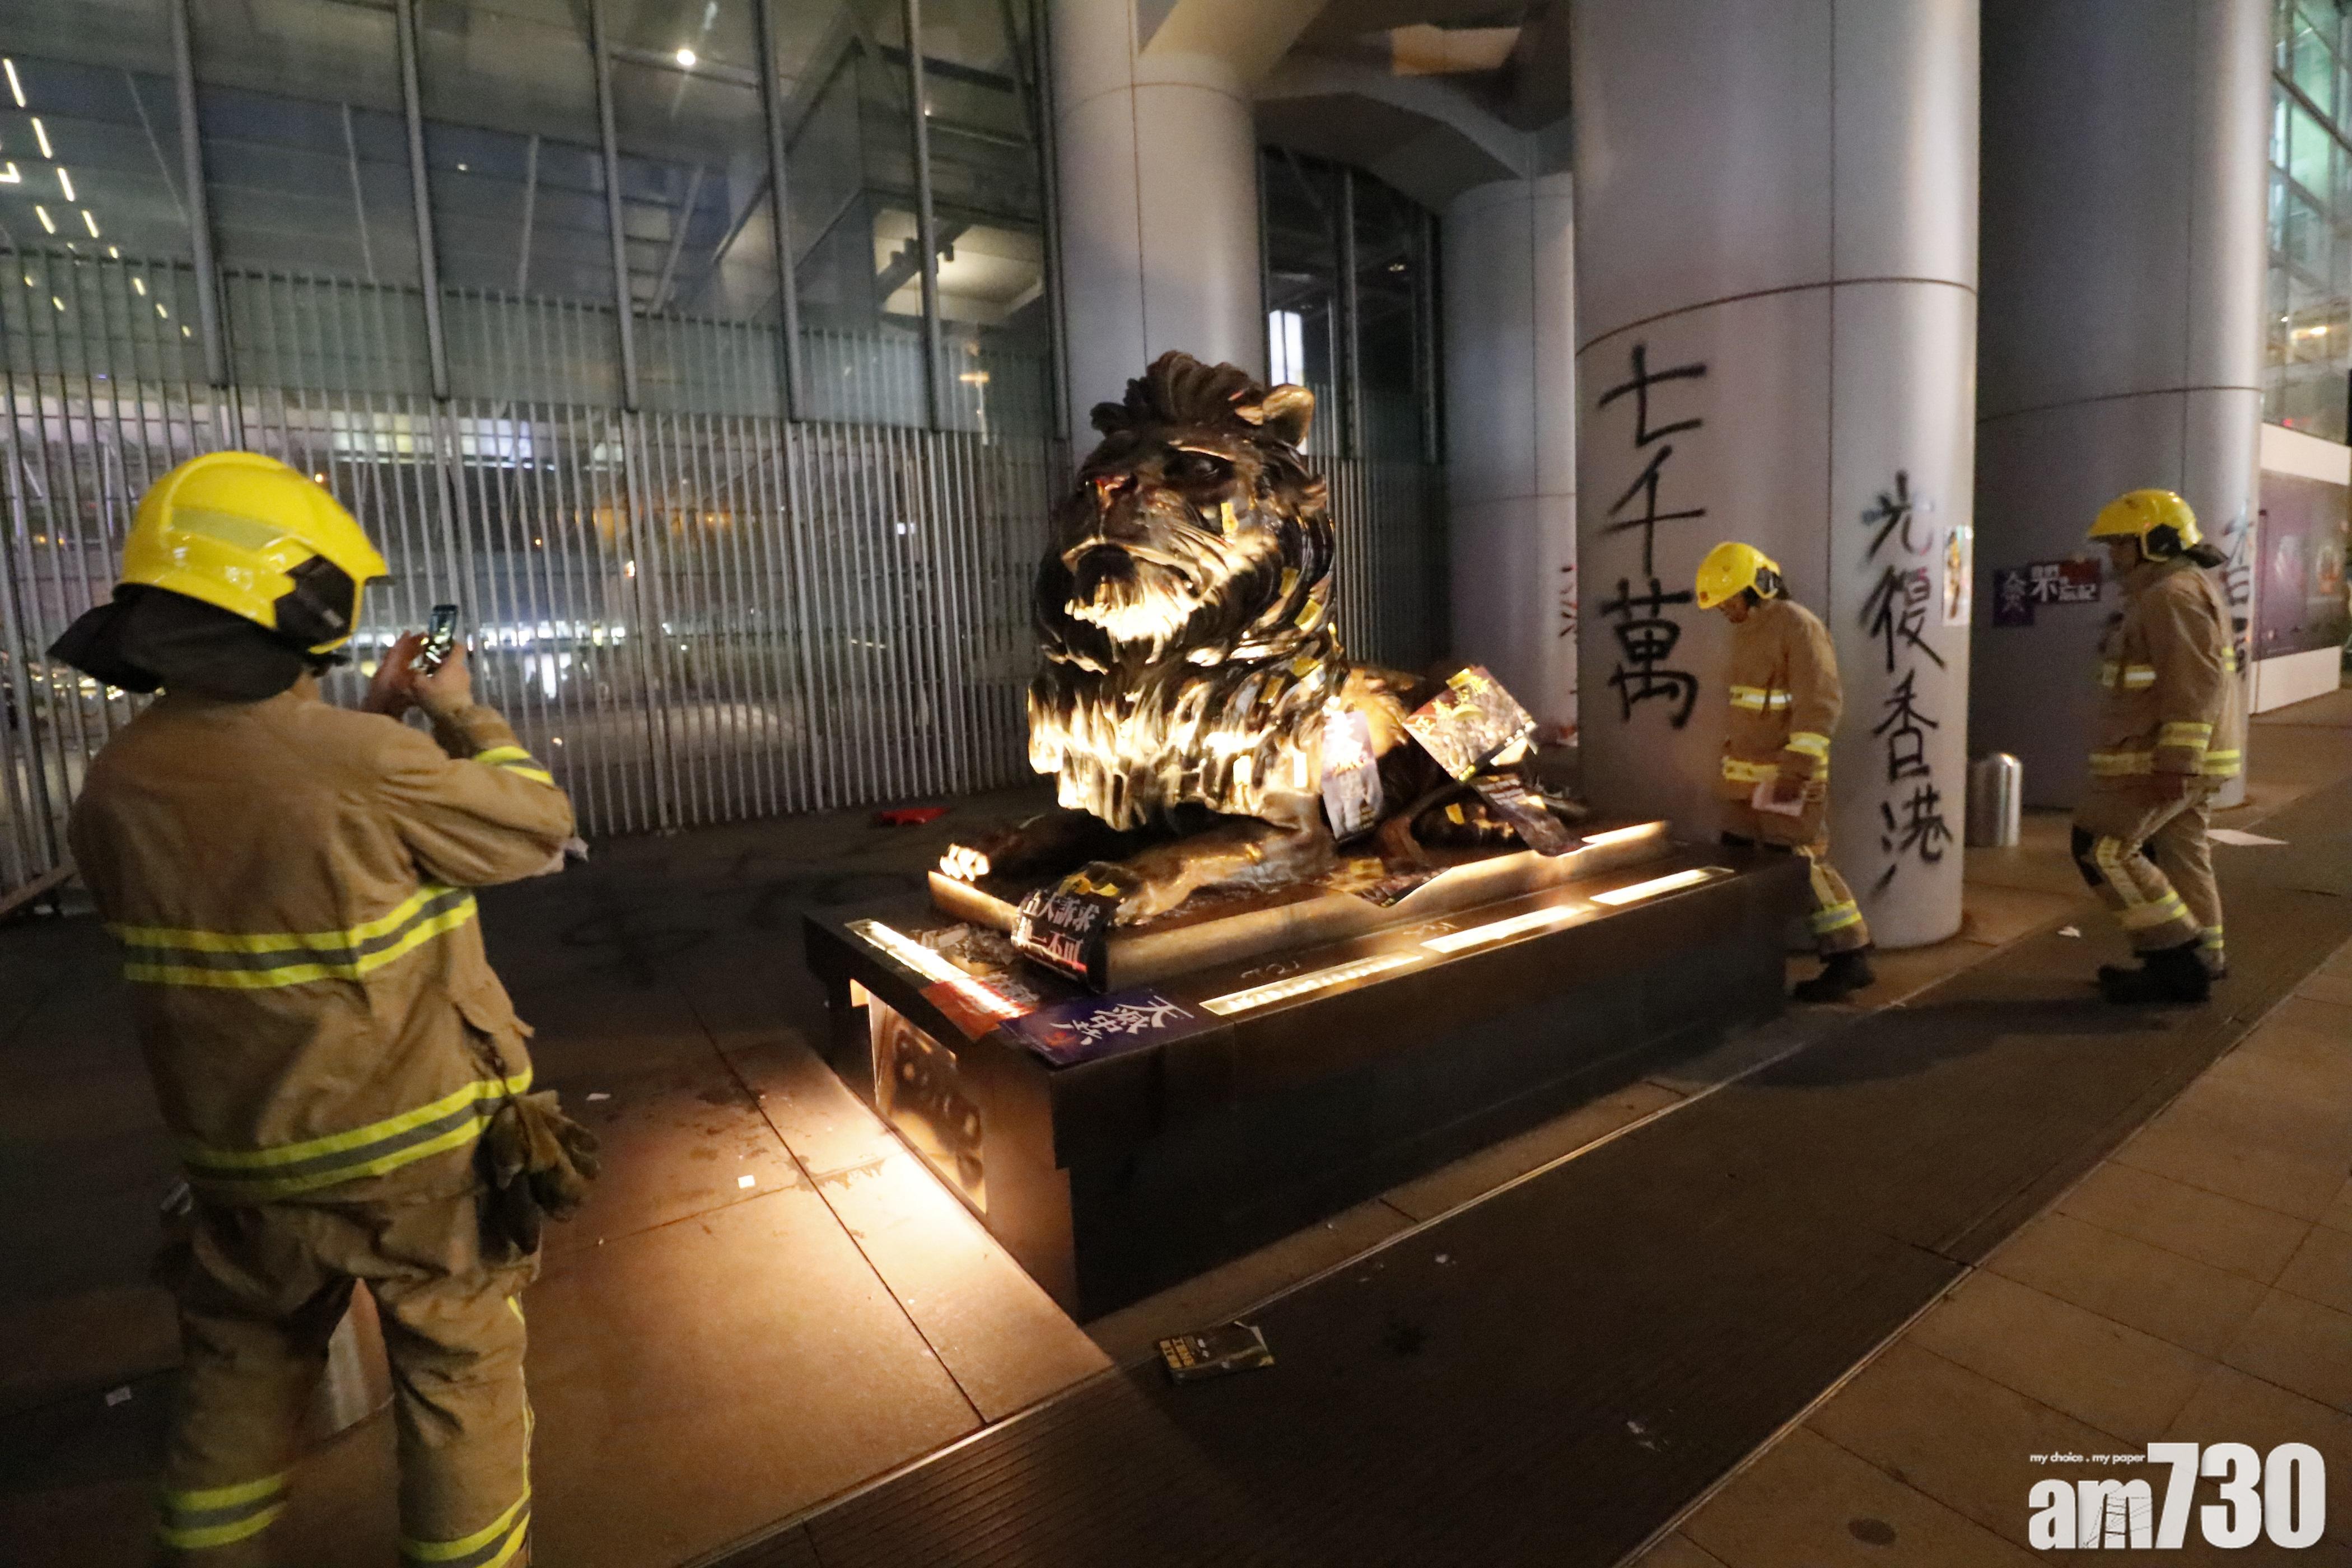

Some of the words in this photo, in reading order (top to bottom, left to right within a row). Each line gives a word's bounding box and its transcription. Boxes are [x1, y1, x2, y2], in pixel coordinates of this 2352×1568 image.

[1598, 344, 1707, 730] 七千萬
[1860, 469, 1953, 889] 光復香港
